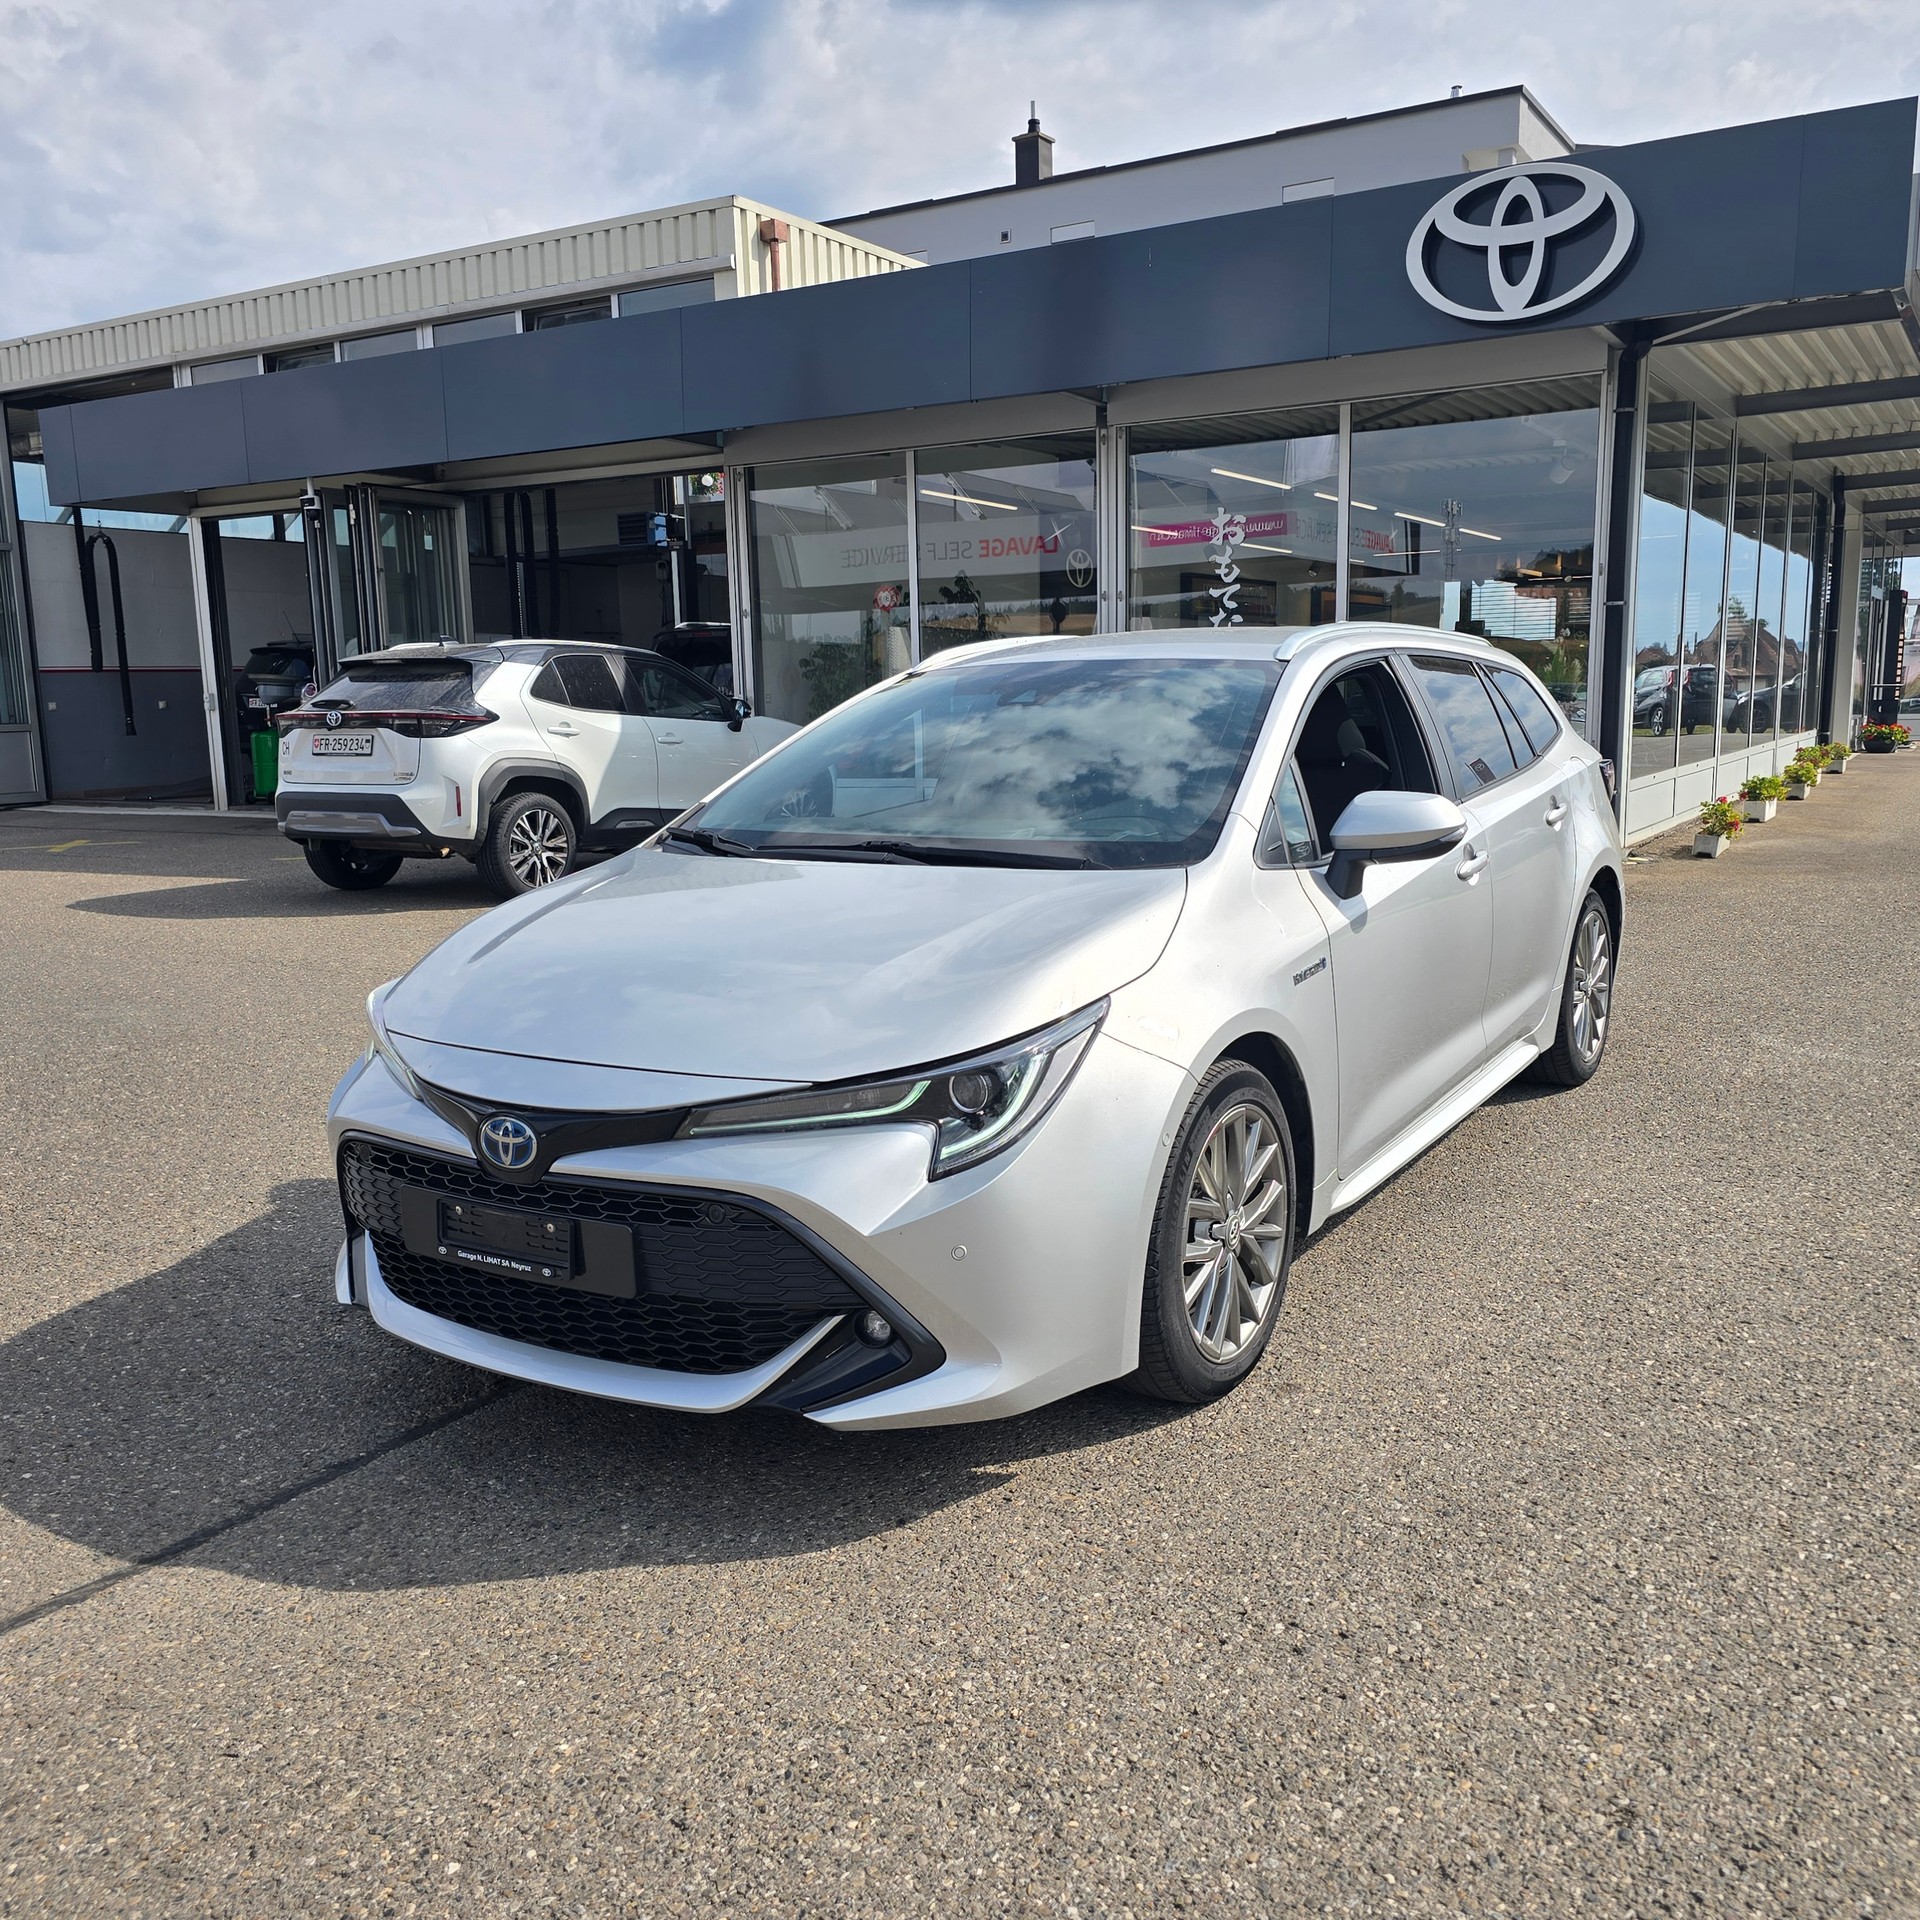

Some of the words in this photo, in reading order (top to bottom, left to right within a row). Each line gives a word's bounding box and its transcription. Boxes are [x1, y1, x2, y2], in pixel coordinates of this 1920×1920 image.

[282, 741, 290, 755] CH
[457, 1250, 477, 1261] Garage
[483, 1255, 501, 1265] LIMAT
[501, 1259, 510, 1267] SA
